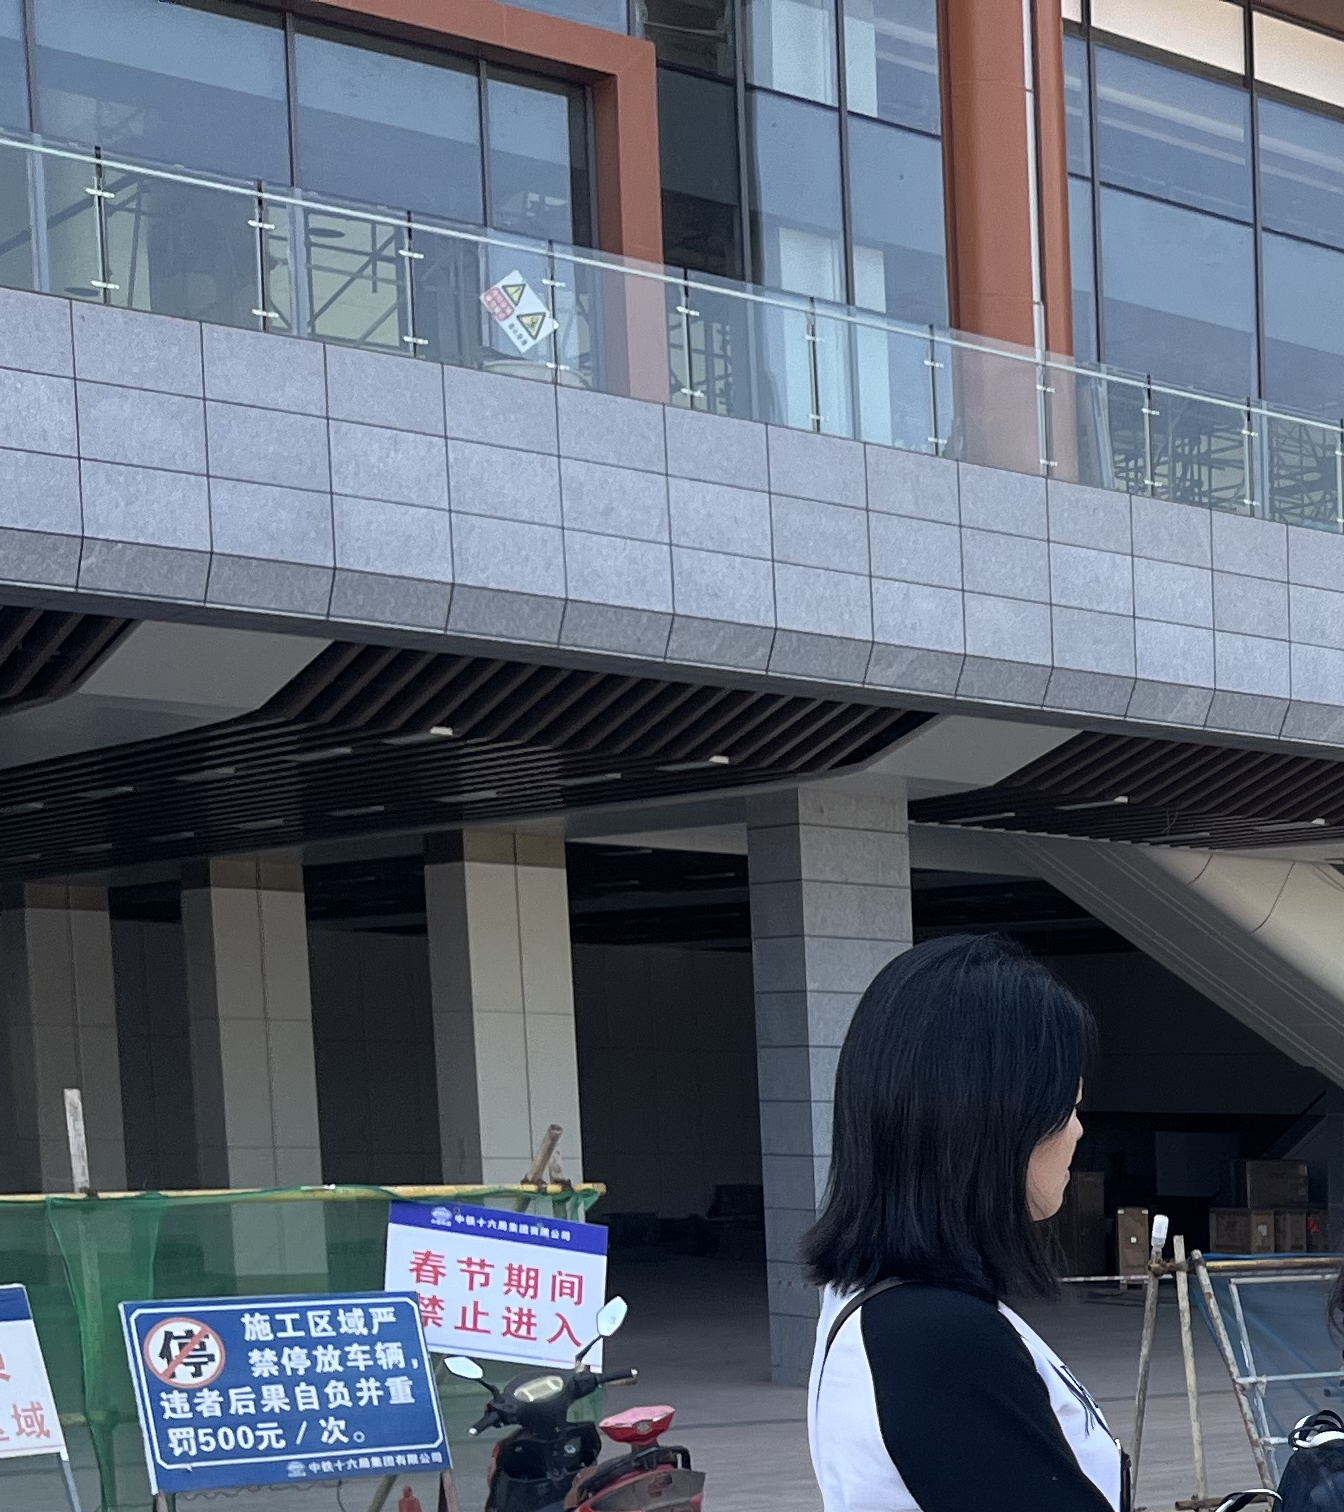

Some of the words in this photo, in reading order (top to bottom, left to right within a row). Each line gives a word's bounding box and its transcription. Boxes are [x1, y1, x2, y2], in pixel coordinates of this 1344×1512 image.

[454, 1213, 571, 1242] 中铁十六局集团有限公司
[408, 1250, 584, 1306] 春节期间
[241, 1306, 396, 1341] 施工区域严
[417, 1292, 582, 1347] 禁止进入
[160, 1376, 416, 1421] 违者后果自负并重
[0, 1401, 51, 1441] 域
[308, 1452, 443, 1475] 中铁十六局集团有限公司
